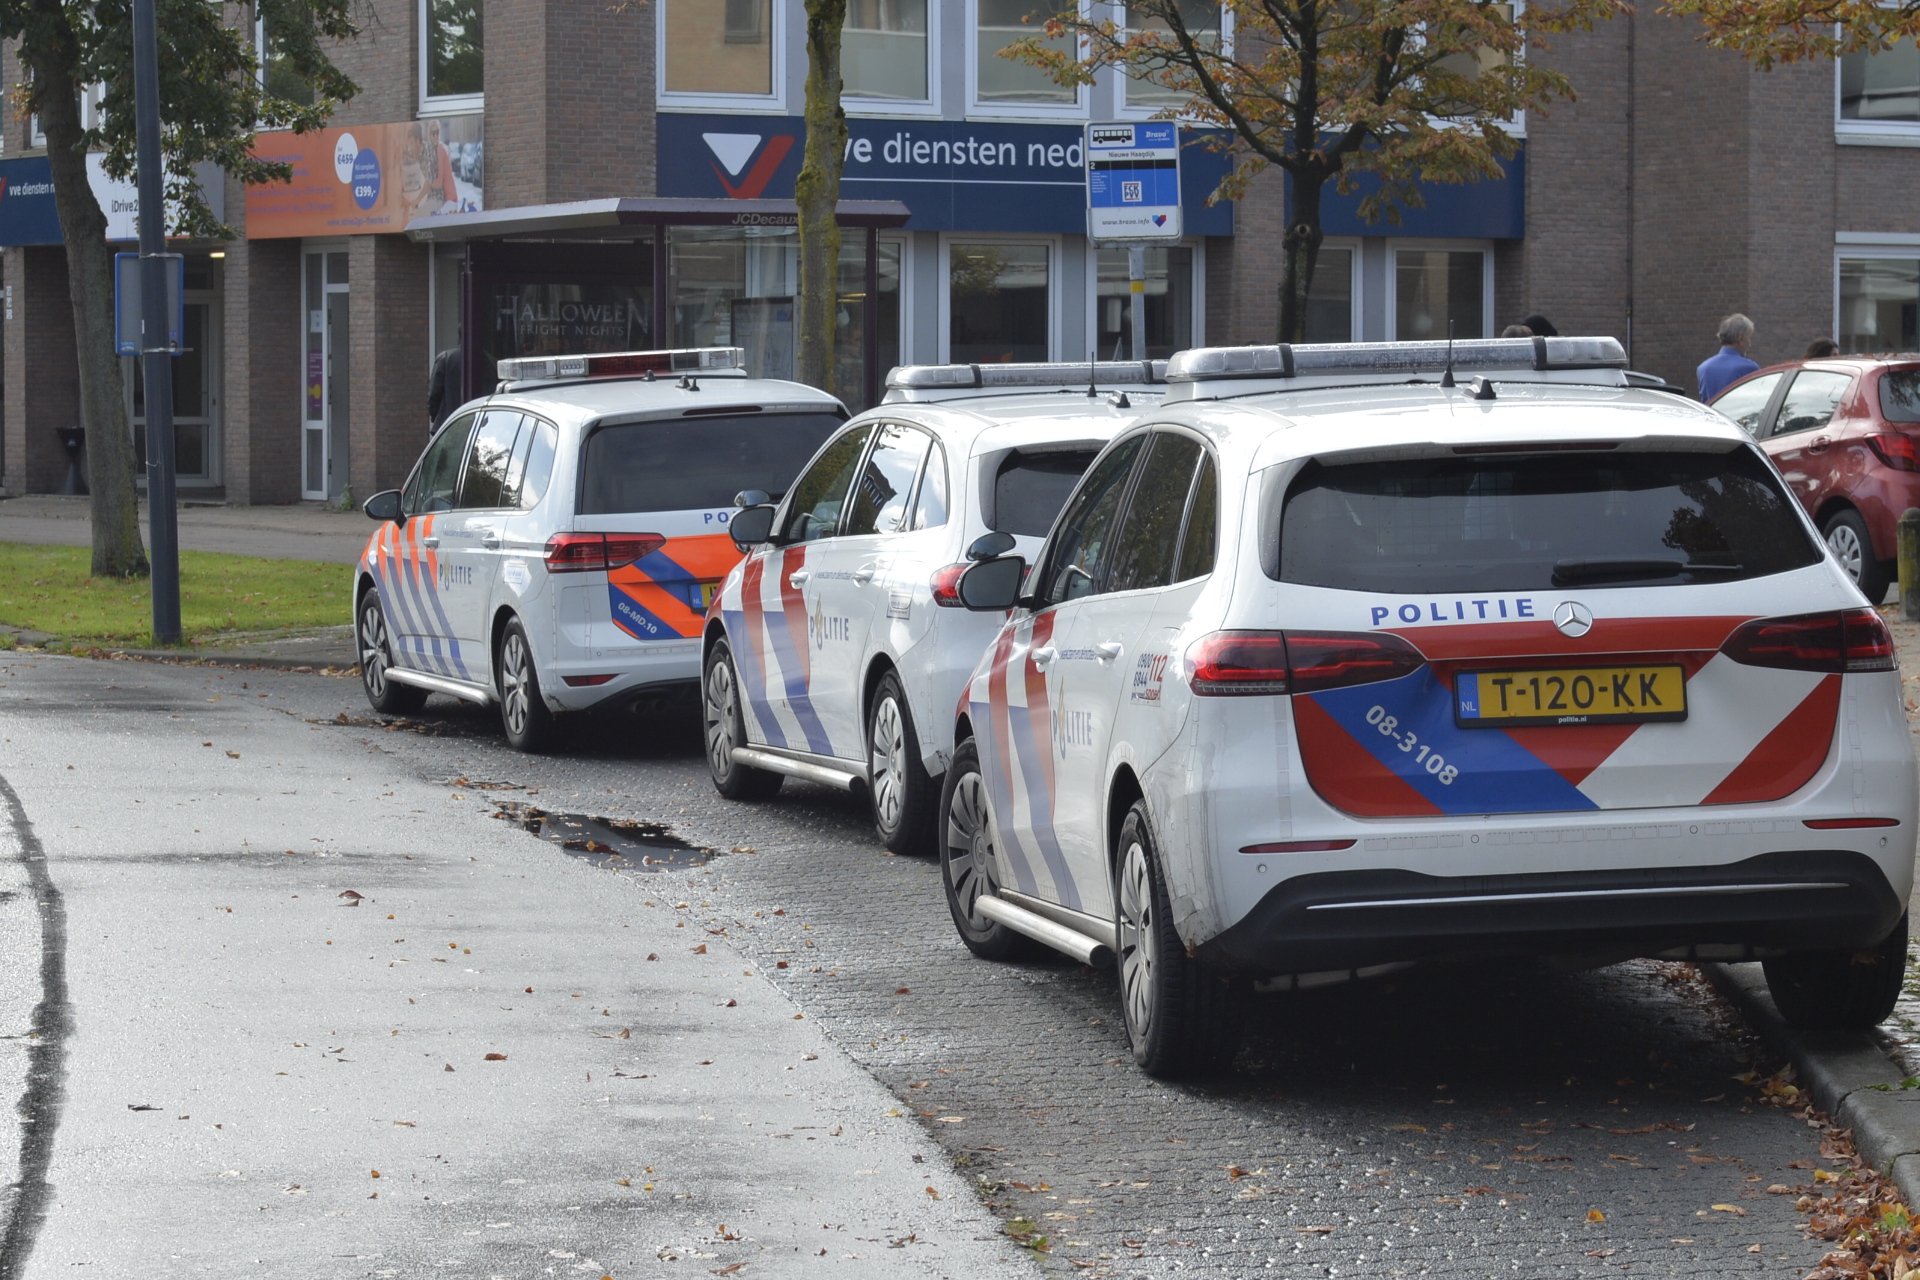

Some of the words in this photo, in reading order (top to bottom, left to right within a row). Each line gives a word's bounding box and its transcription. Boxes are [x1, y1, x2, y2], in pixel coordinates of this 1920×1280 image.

[883, 132, 1016, 167] diensten
[1027, 137, 1084, 168] ned
[1108, 151, 1129, 159] Nieuwe
[1131, 151, 1155, 159] Haagdijk
[22, 182, 49, 196] diensten
[496, 295, 649, 352] HALLOWEEN
[520, 325, 567, 336] FRIGHT
[575, 326, 625, 337] NIGHTS
[703, 511, 737, 524] PO
[617, 601, 658, 634] 08-MD.10
[1370, 597, 1536, 626] POLITIE
[1149, 654, 1168, 682] 112
[1491, 673, 1664, 712] T-120-KK
[1461, 701, 1477, 713] NL
[1558, 715, 1588, 724] politie.nl
[1365, 704, 1460, 787] 08-3108
